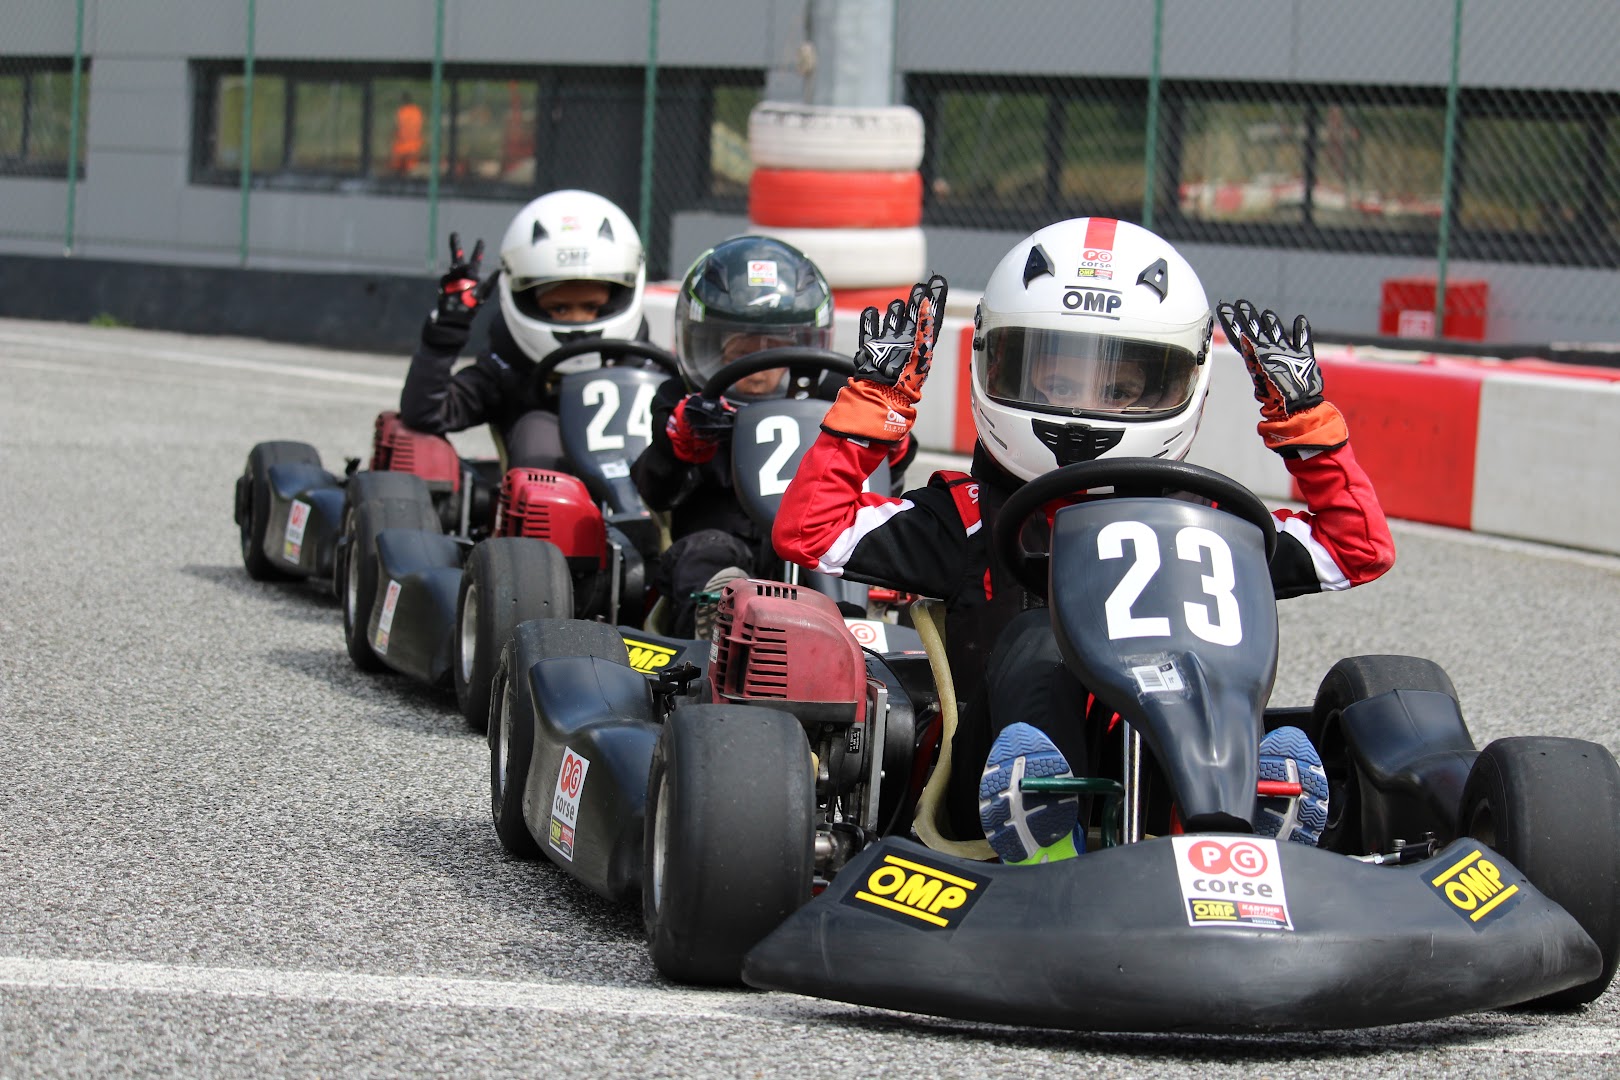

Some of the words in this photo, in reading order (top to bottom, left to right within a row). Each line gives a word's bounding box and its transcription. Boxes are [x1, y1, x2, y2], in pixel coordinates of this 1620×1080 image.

[1085, 251, 1110, 260] PG
[1063, 291, 1122, 313] OMP
[582, 379, 656, 452] 24
[755, 415, 801, 497] 2
[1097, 520, 1243, 647] 23
[628, 647, 670, 671] MP
[562, 758, 581, 793] PG
[555, 794, 575, 821] corse
[1197, 843, 1260, 872] PG
[868, 866, 967, 914] OMP
[1193, 879, 1273, 898] corse
[1444, 859, 1504, 911] OMP
[1194, 904, 1235, 917] OMP
[1241, 904, 1280, 913] KARTING
